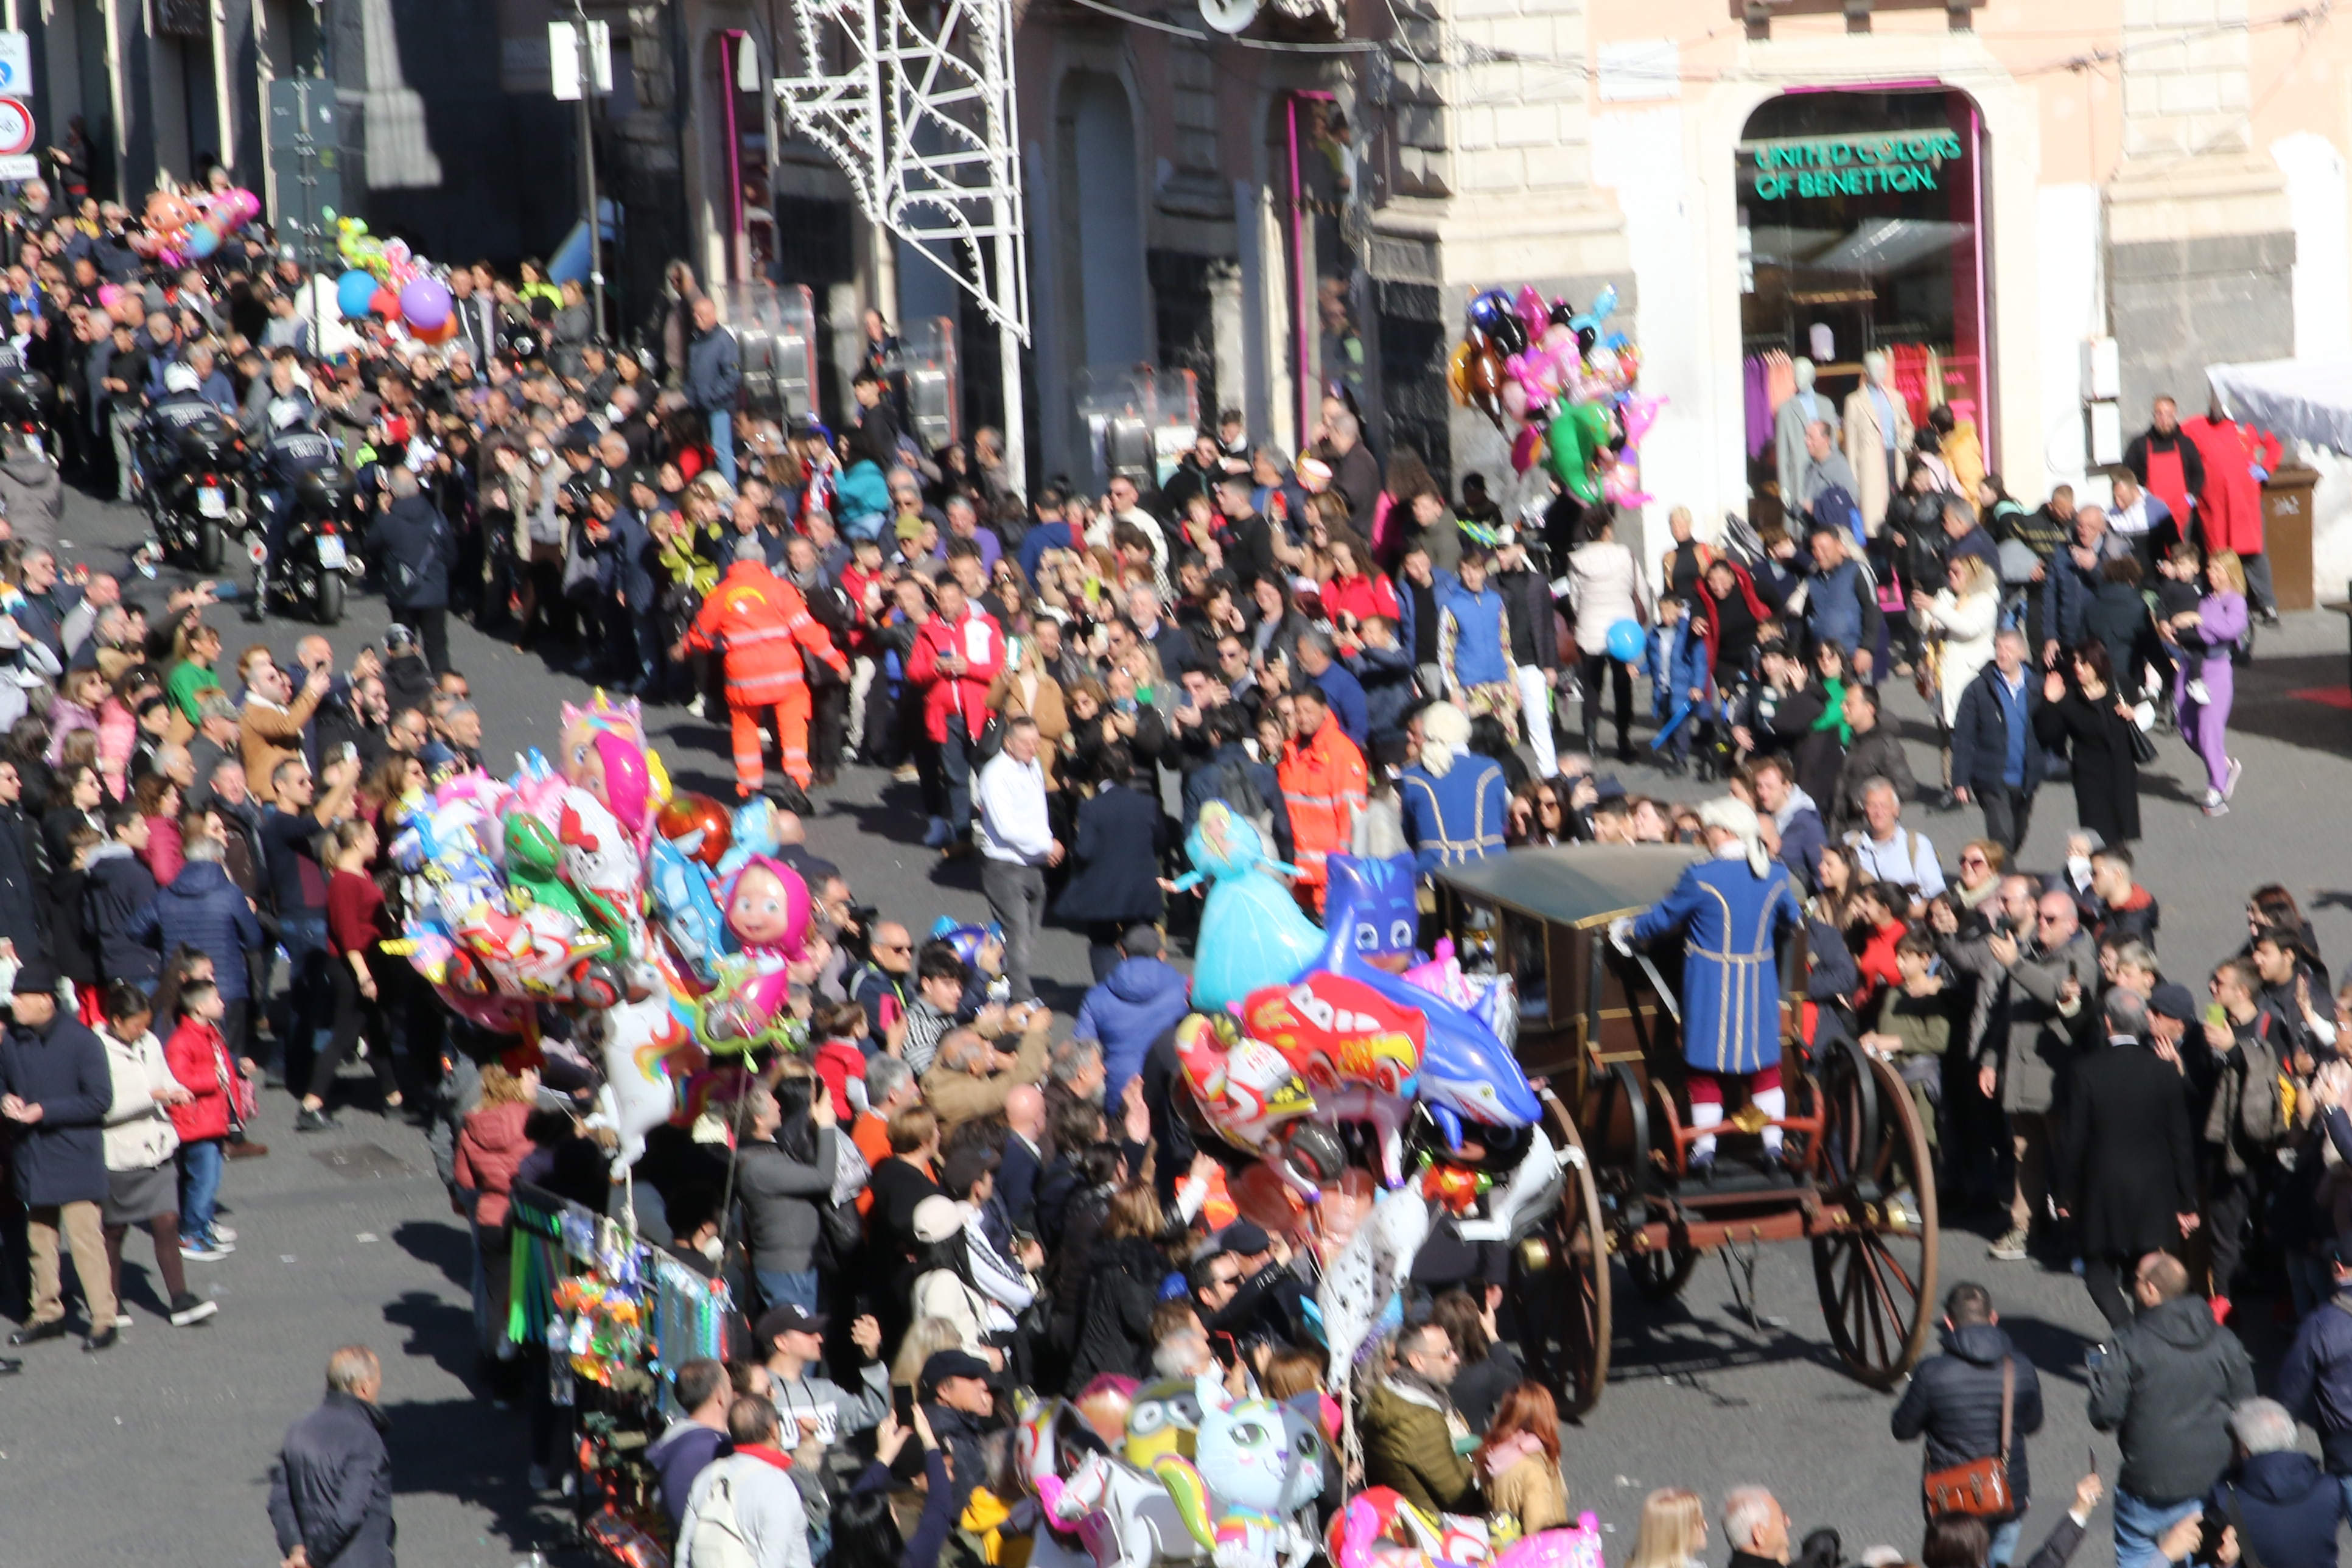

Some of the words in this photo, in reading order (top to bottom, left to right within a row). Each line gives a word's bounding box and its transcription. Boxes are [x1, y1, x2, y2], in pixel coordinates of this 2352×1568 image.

[1754, 140, 1852, 171] UNITED
[1855, 130, 1962, 165] COLORS
[1754, 170, 1793, 201] OF
